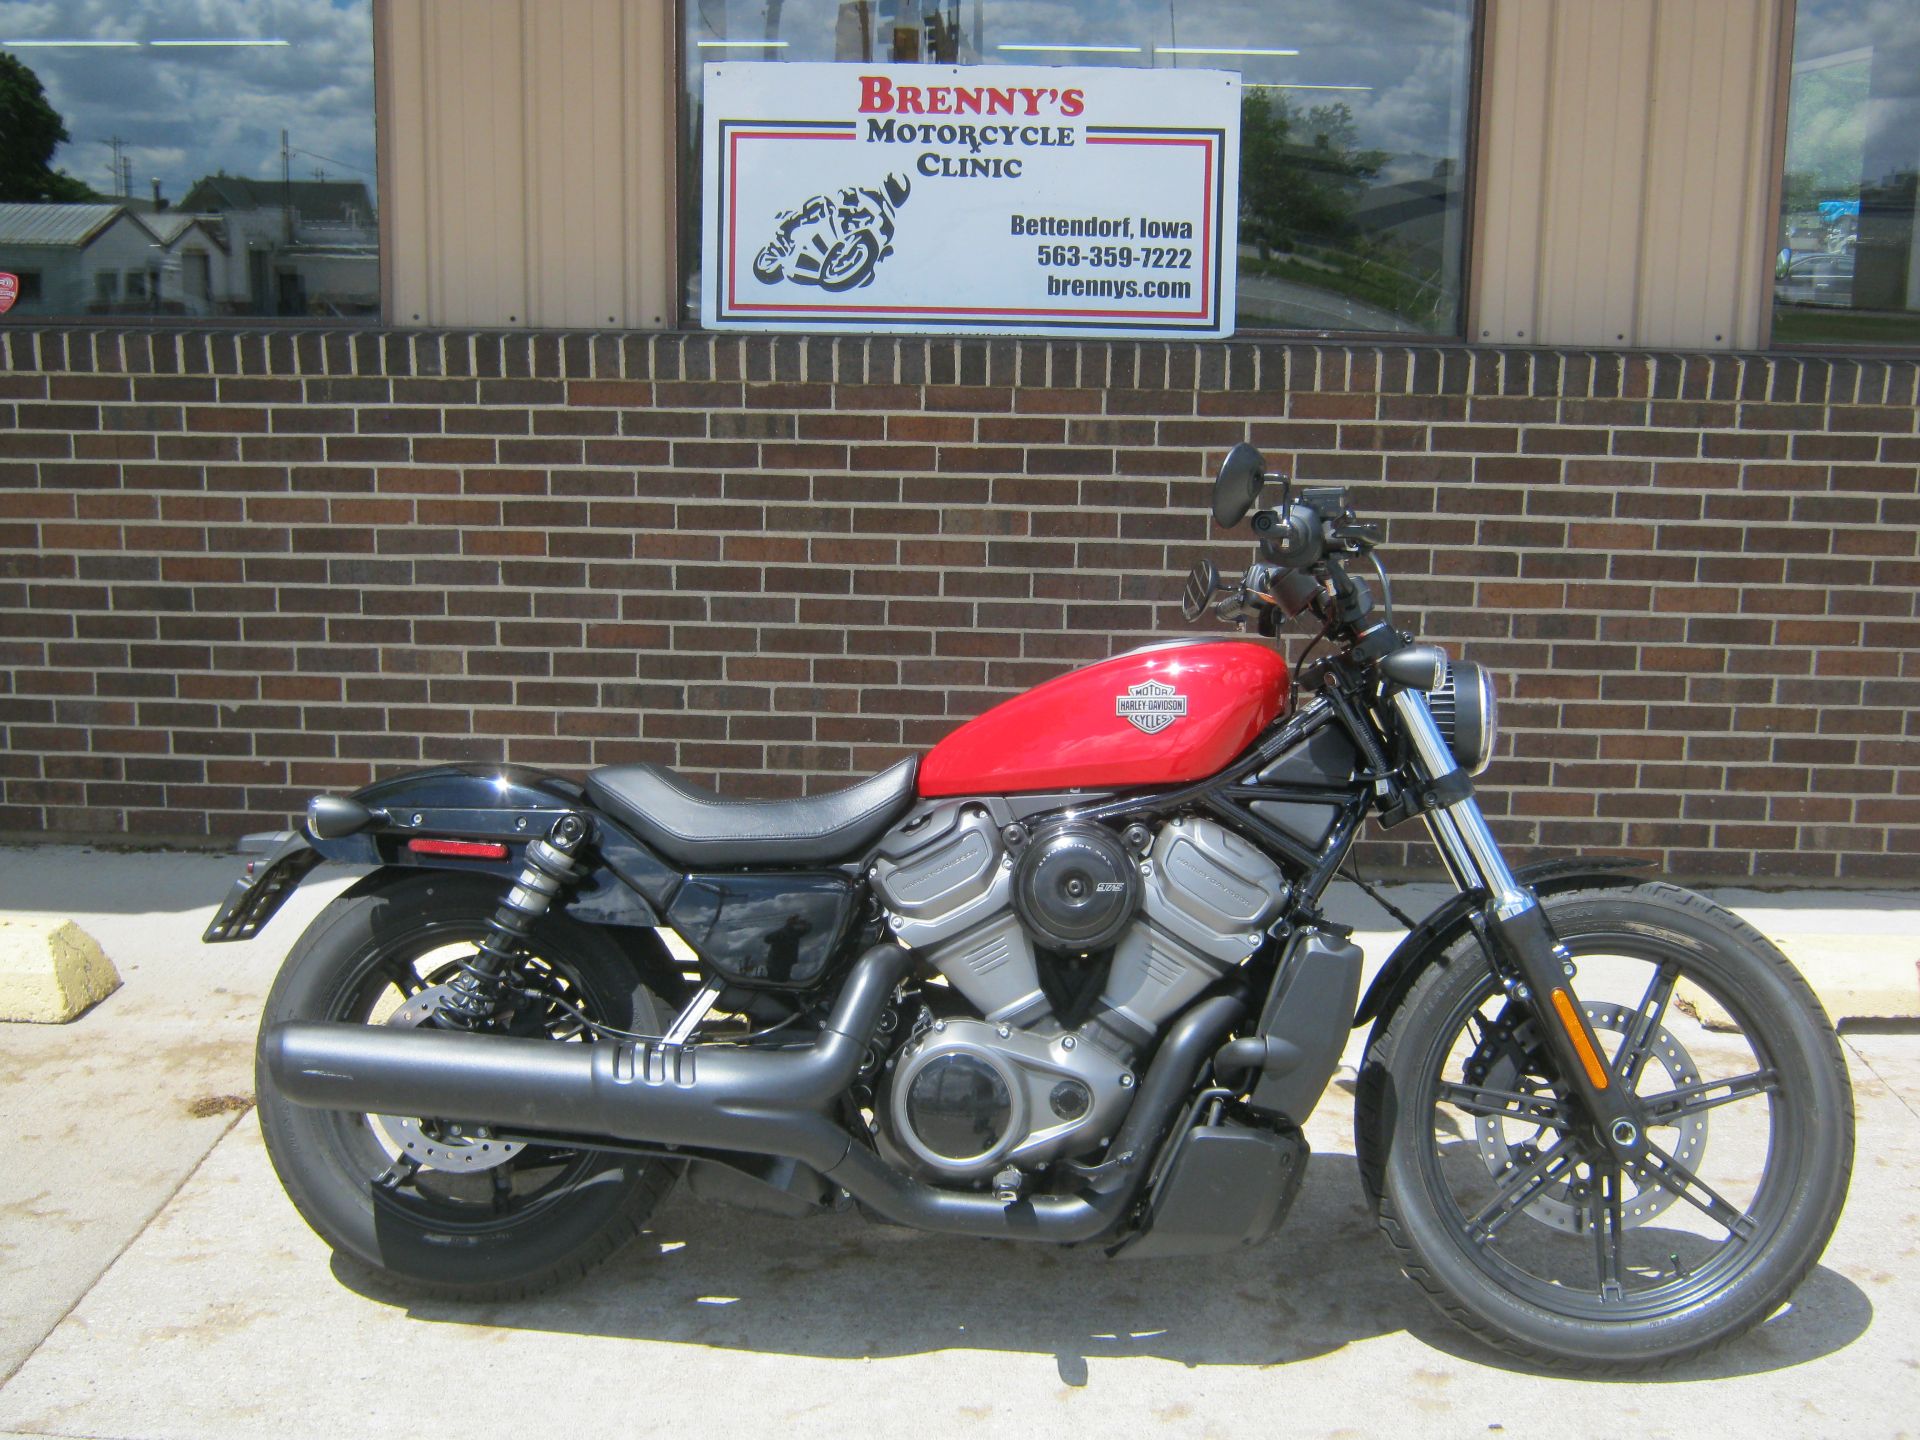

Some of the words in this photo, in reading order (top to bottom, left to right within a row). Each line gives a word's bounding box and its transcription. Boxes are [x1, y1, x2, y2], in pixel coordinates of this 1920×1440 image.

[858, 76, 1084, 116] BRENNY'S
[867, 119, 1074, 153] MOTORCYCLE
[917, 153, 1022, 178] CLINIC
[1011, 215, 1134, 240] Bettendorf,
[1140, 218, 1192, 239] Iowa
[1038, 245, 1192, 269] 563-359-7222
[1047, 275, 1191, 299] brennys.com
[1135, 684, 1168, 696] MOTOR
[1120, 700, 1182, 711] HARLEY-DAVIDSON
[1135, 714, 1168, 728] CYCLES
